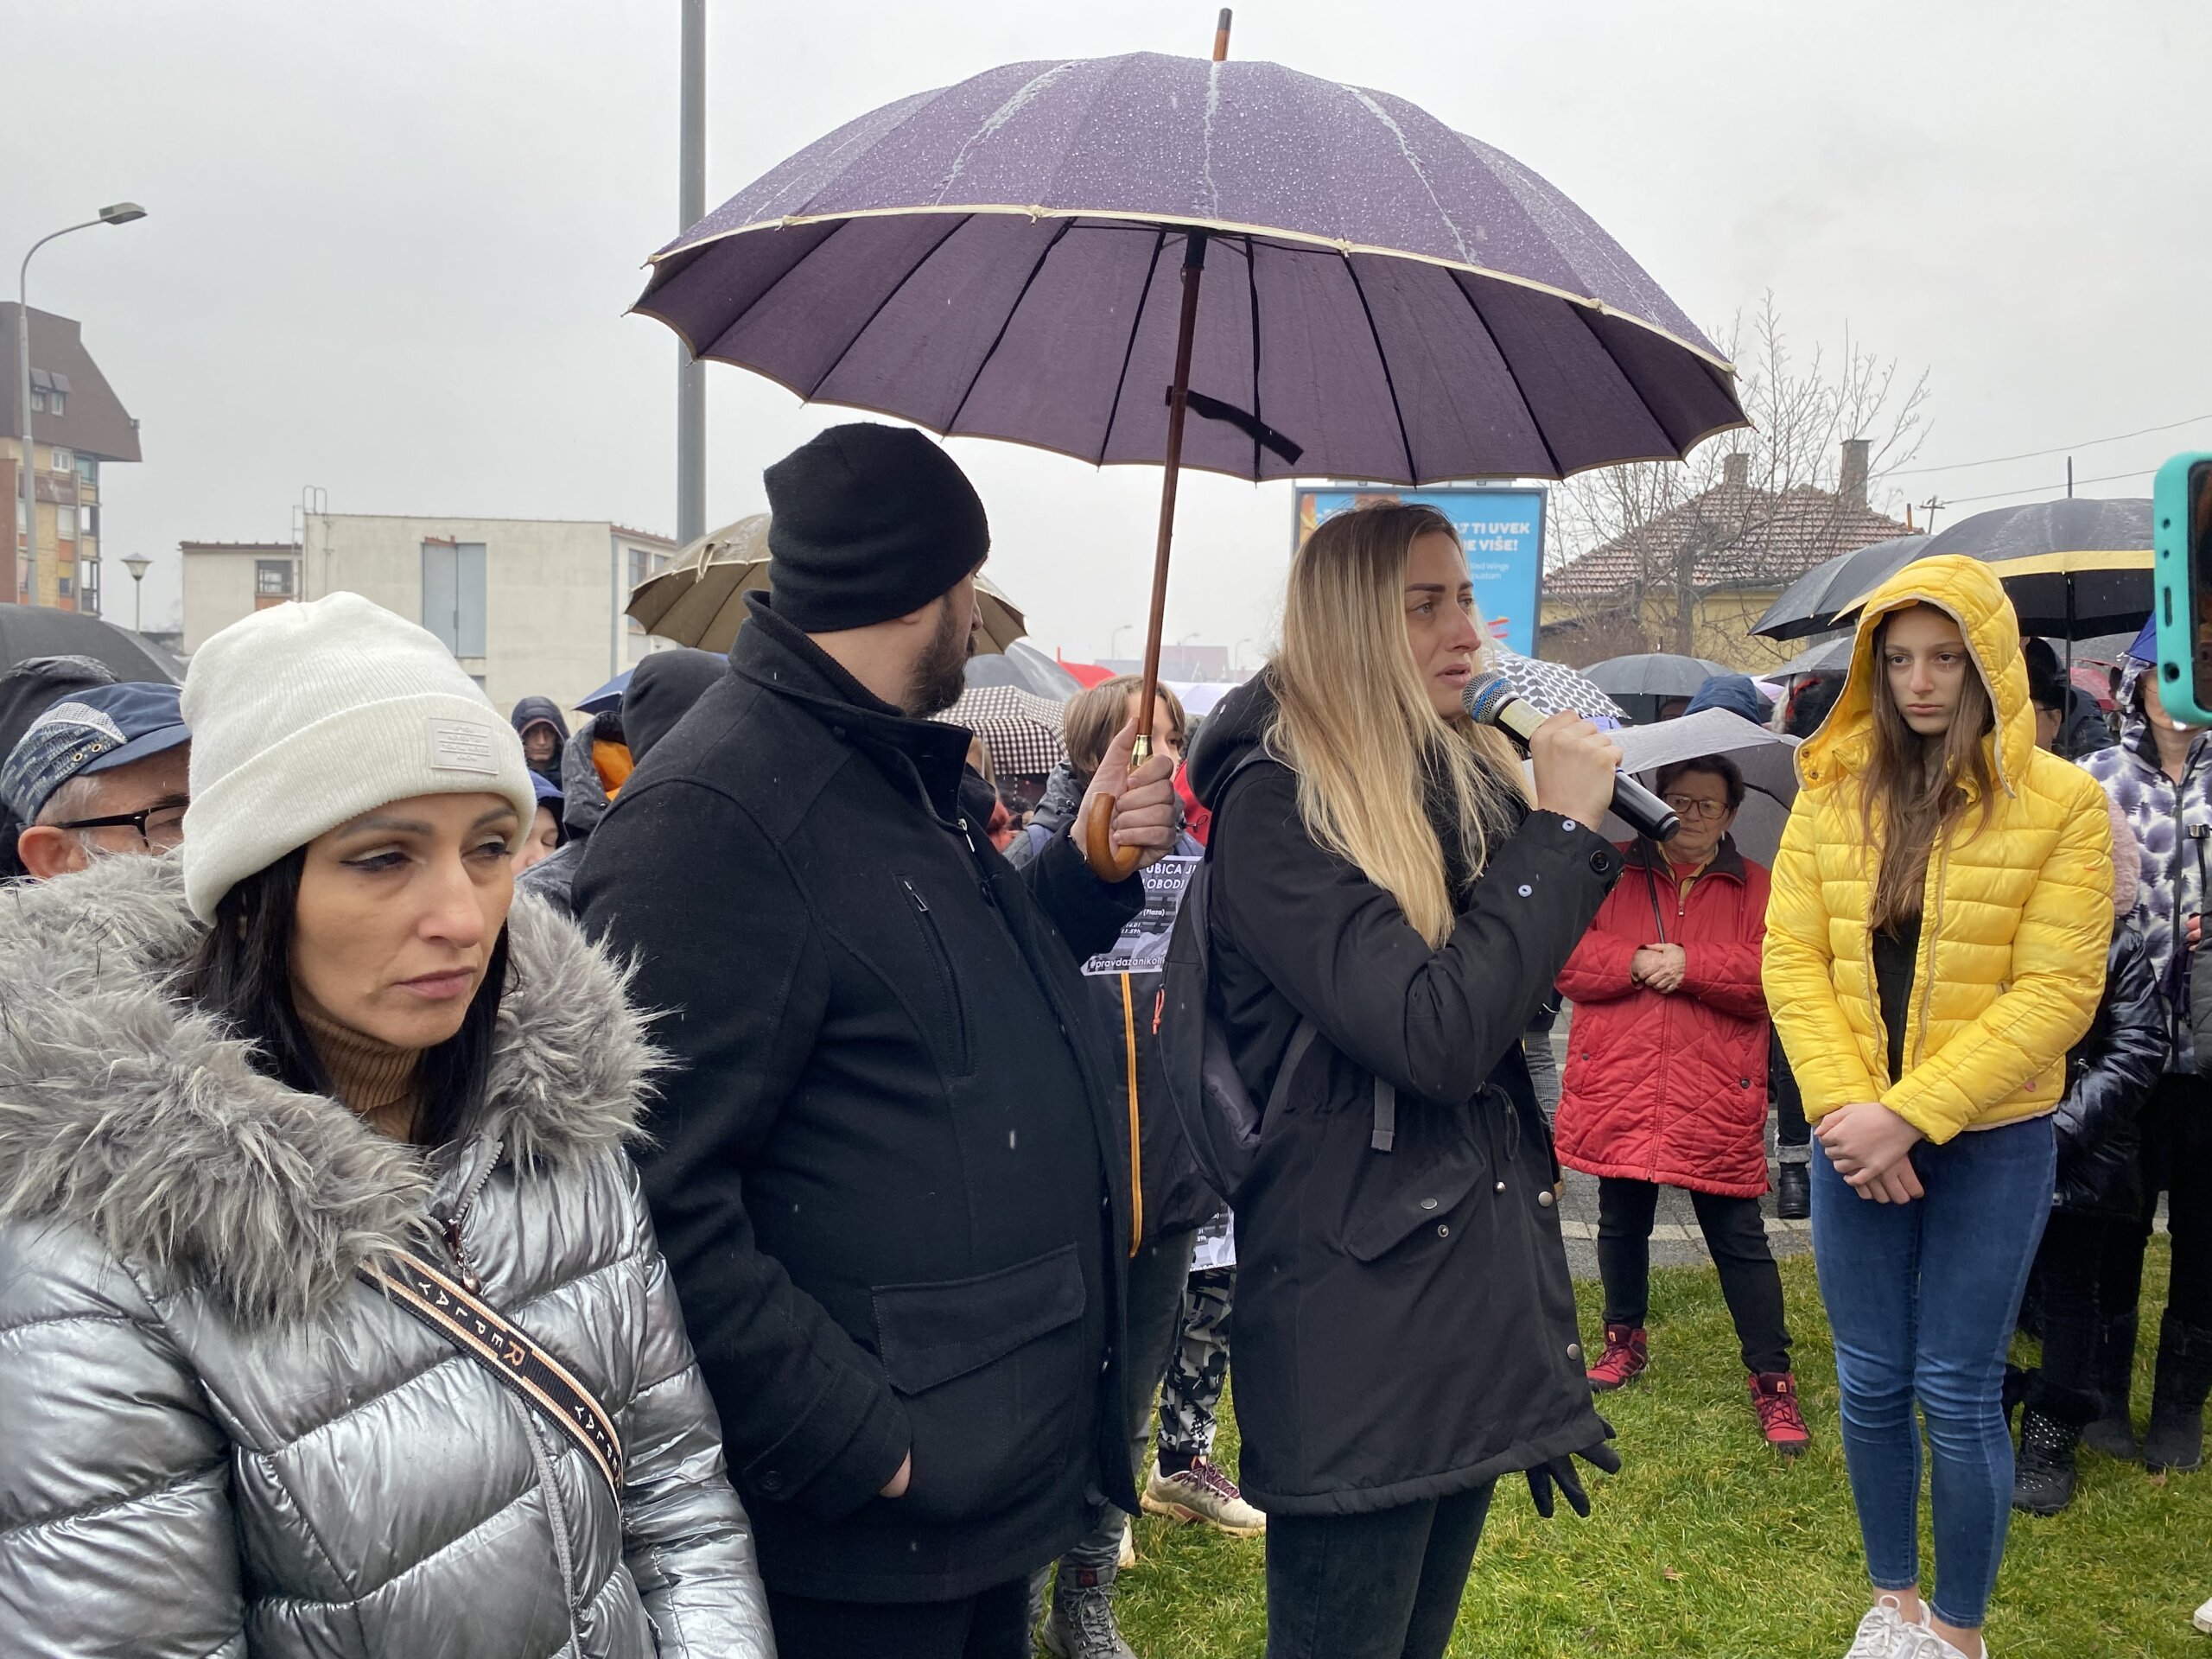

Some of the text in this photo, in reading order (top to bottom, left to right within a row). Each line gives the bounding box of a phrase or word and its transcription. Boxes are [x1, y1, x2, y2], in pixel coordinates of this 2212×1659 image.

[1471, 523, 1486, 534] TI
[1488, 522, 1530, 534] UVEK
[1478, 535, 1518, 551] VIŠE!
[1141, 878, 1185, 889] LOBODI
[1143, 908, 1165, 917] (Plaza)
[418, 1281, 526, 1366] REPLAY
